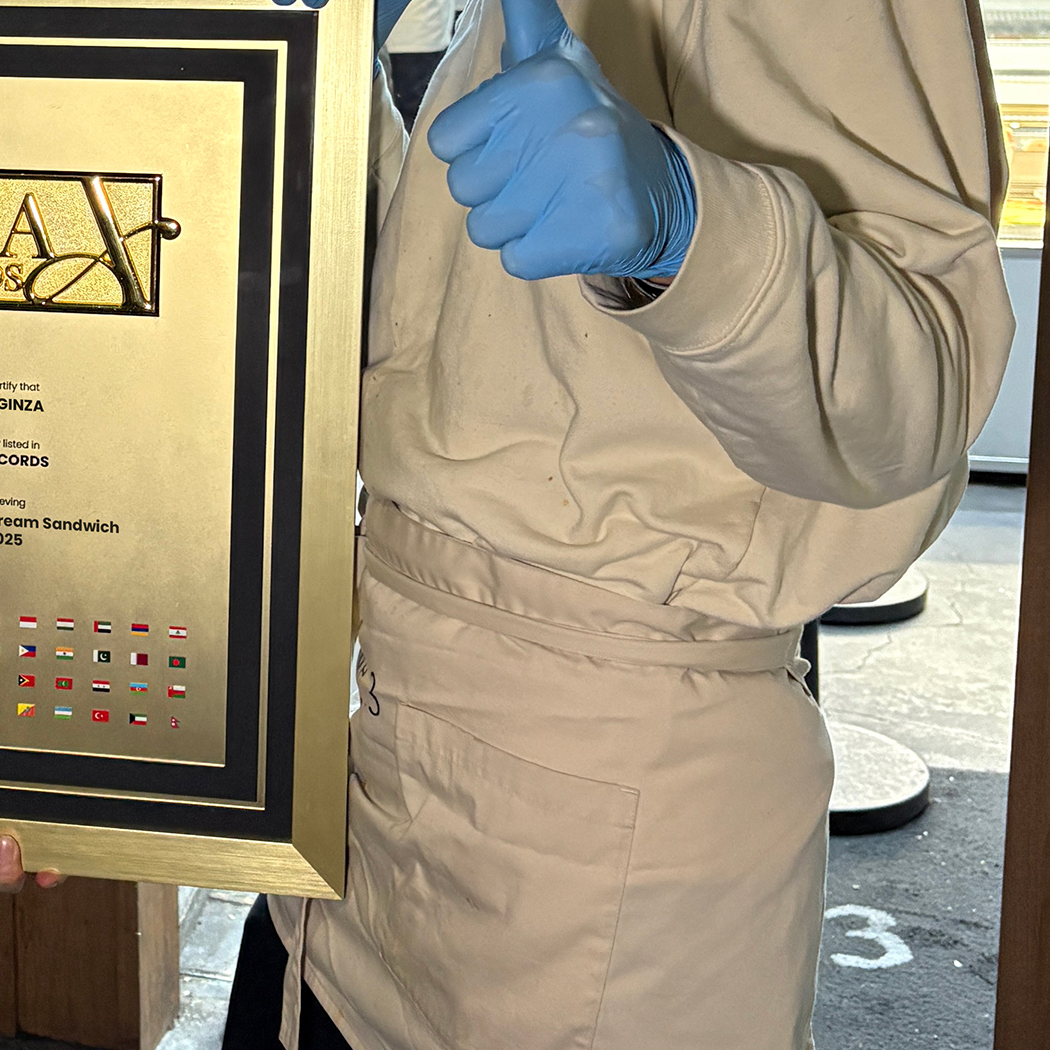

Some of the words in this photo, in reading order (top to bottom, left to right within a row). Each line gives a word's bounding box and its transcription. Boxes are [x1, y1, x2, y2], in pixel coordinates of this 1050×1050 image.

[20, 382, 41, 392] that
[2, 438, 30, 450] listed
[31, 440, 41, 450] in
[42, 517, 121, 534] Sandwich
